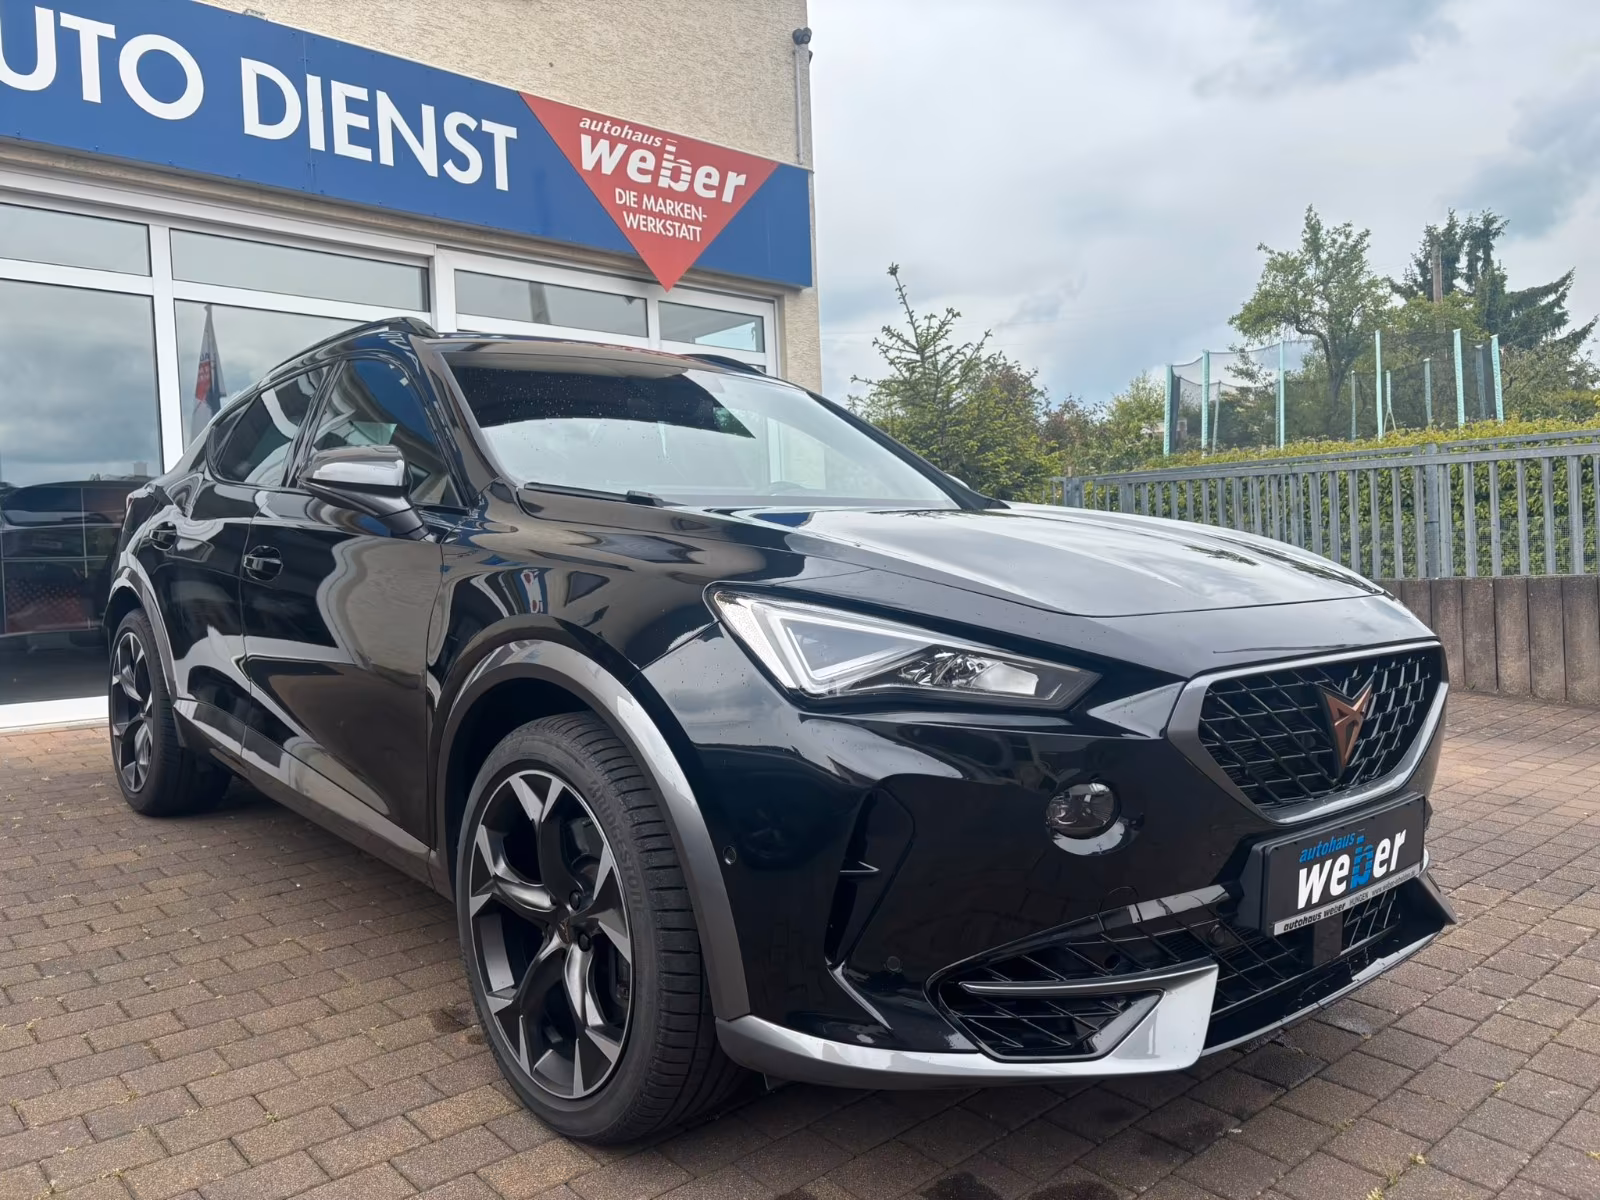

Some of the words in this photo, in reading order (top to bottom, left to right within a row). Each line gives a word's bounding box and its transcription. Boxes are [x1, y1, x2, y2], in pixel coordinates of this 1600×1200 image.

[241, 57, 518, 191] DIENST
[579, 117, 663, 148] autohaus
[580, 133, 747, 203] weber
[615, 188, 638, 208] DIE
[642, 194, 708, 222] MARKEN-
[623, 211, 702, 242] WERKSTATT
[1299, 832, 1356, 863] autohaus
[1297, 828, 1406, 910] weber
[1283, 911, 1322, 931] autohaus
[1323, 902, 1346, 917] weber
